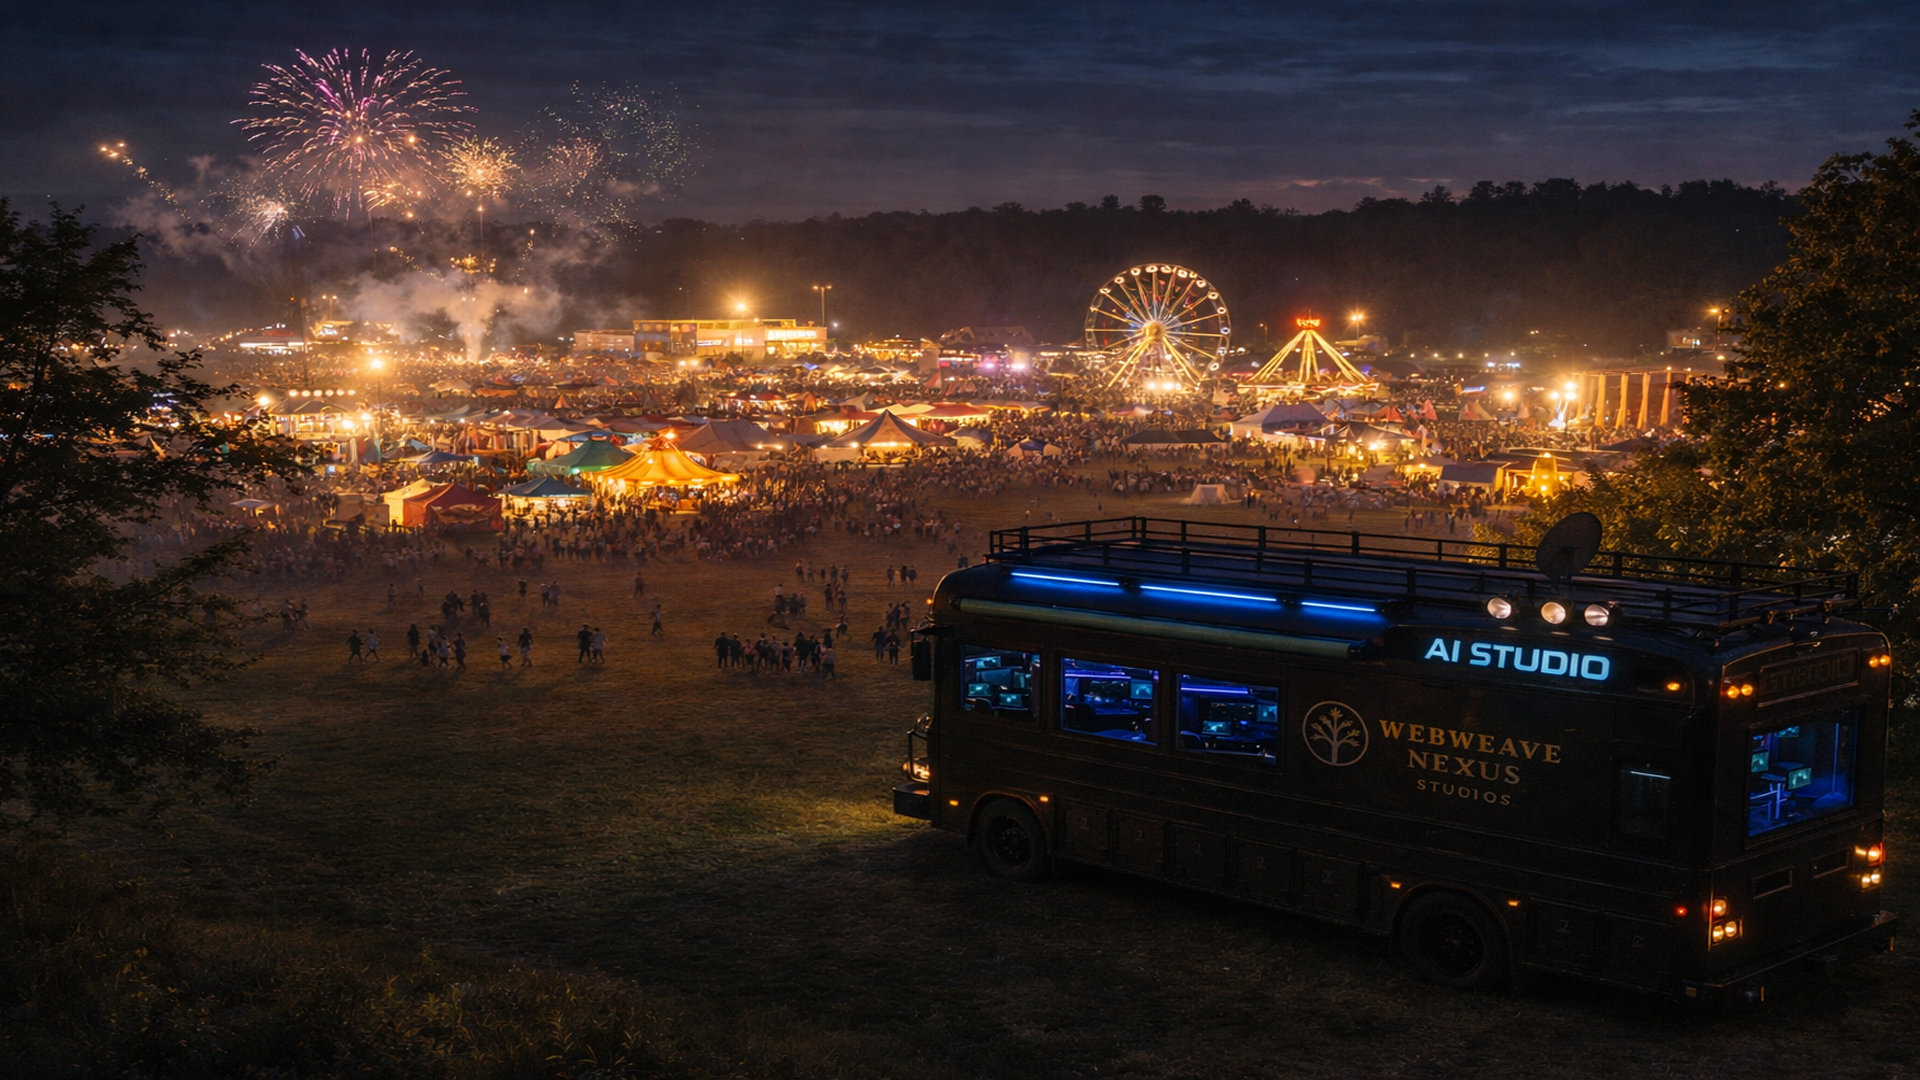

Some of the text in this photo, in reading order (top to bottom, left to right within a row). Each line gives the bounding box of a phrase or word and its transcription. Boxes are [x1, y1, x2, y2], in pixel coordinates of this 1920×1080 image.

[1424, 637, 1610, 681] AI STUDIO
[1379, 719, 1562, 764] WEBWEAVE
[1407, 749, 1520, 785] NEXUS
[1416, 779, 1511, 806] STUDIOS
